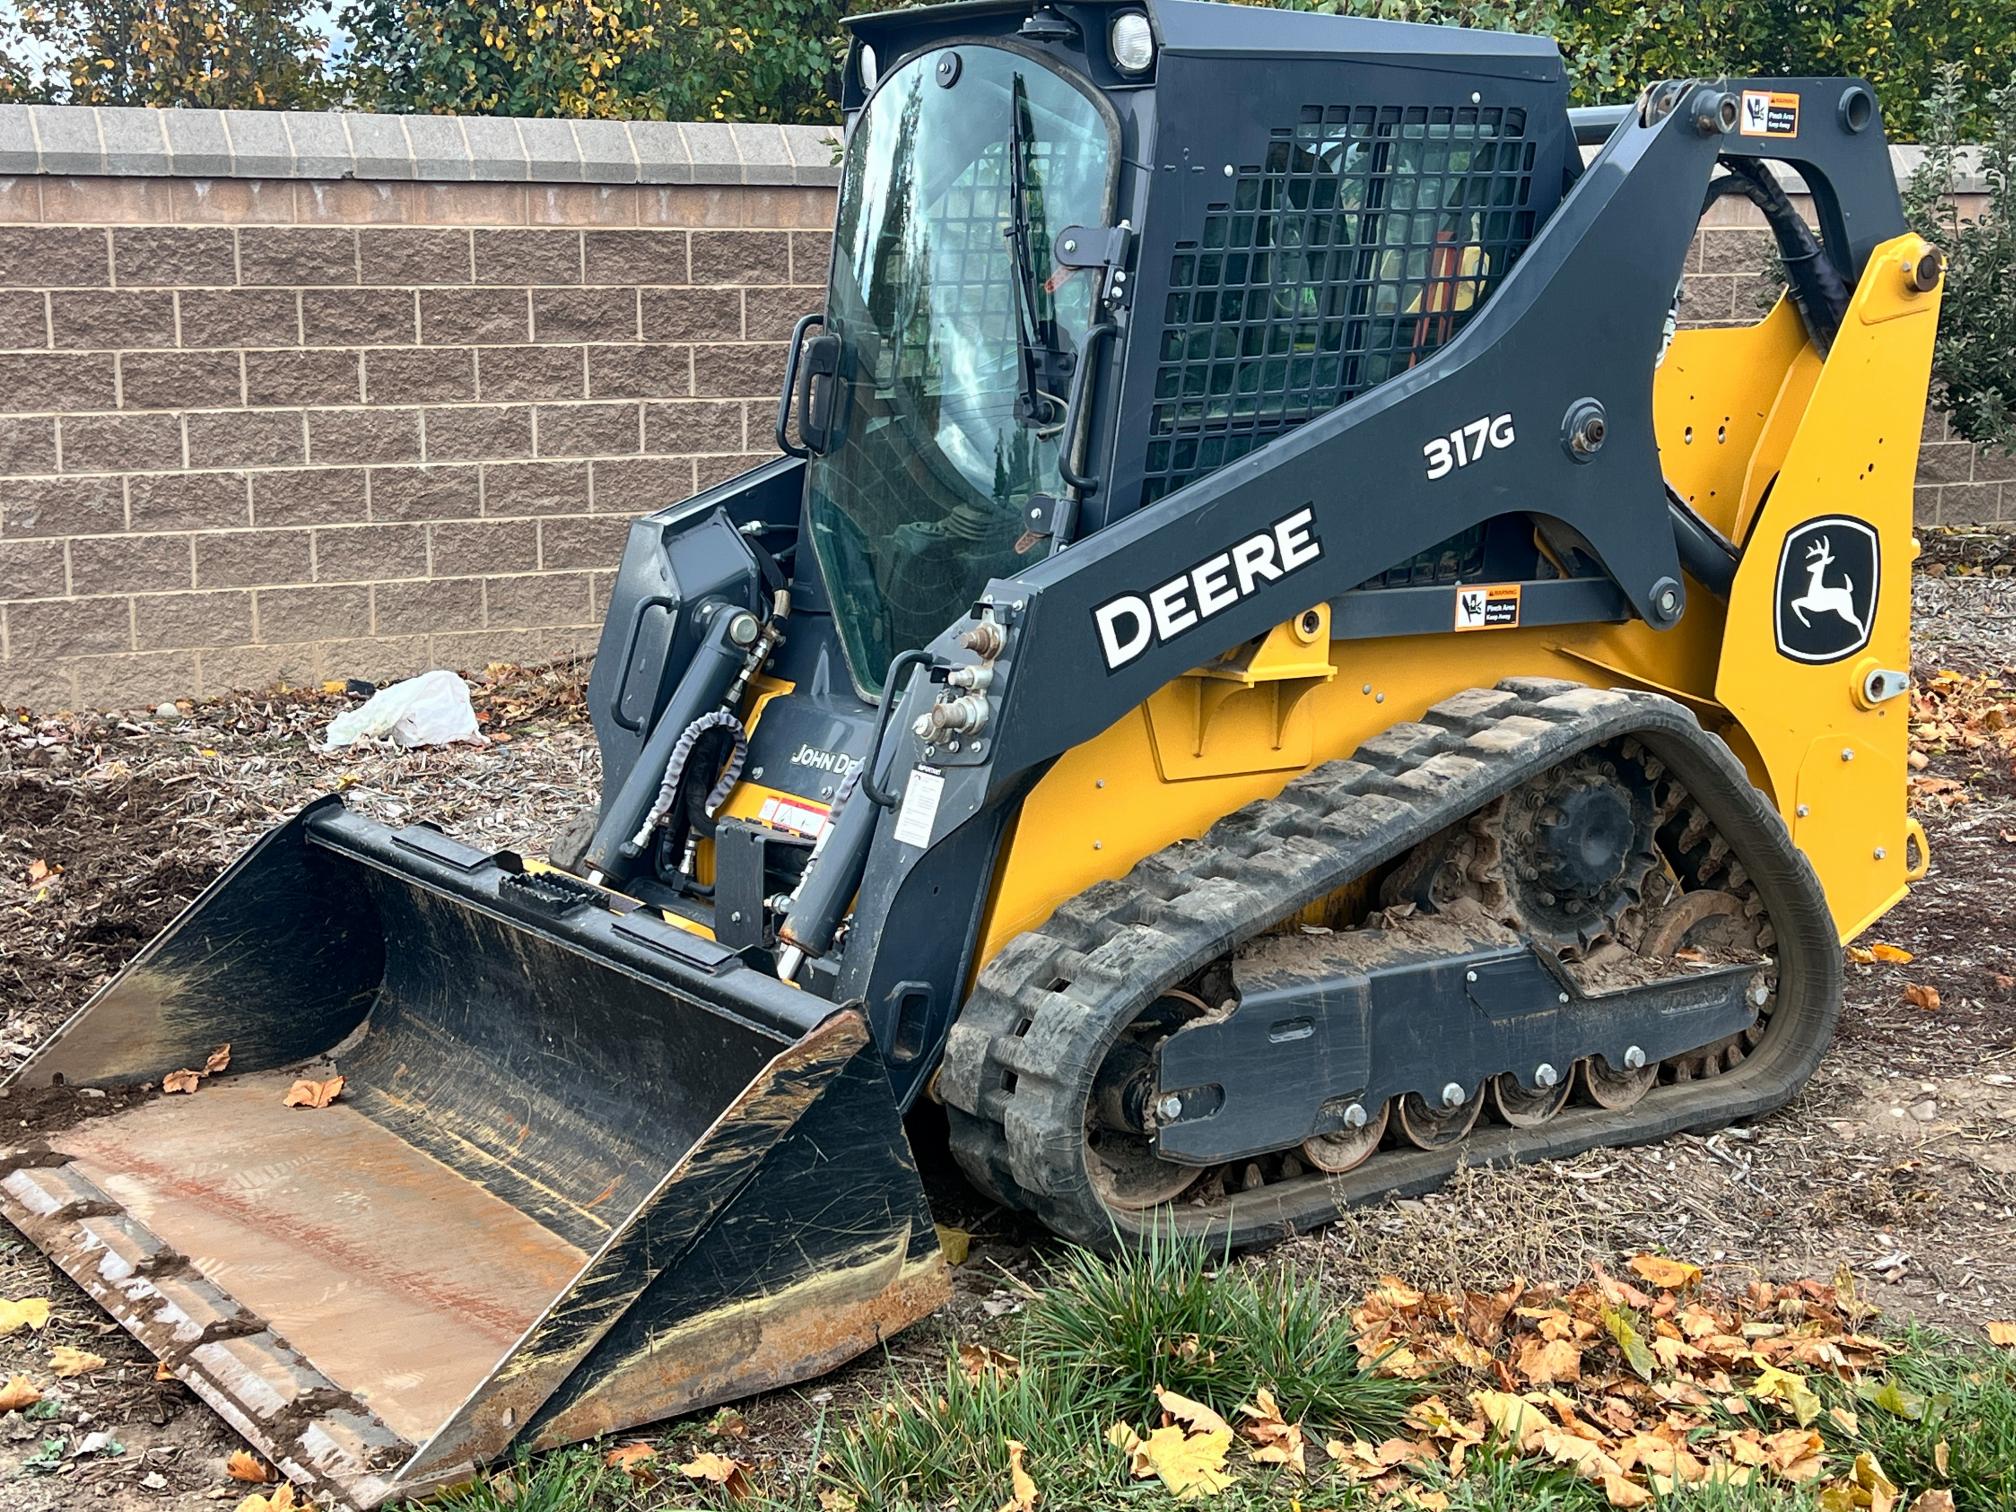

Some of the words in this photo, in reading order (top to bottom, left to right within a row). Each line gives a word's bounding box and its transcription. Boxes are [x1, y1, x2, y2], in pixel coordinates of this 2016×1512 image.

[1782, 112, 1795, 120] Area
[1423, 413, 1515, 480] 317G
[1095, 507, 1321, 669] DEERE
[1486, 604, 1502, 613] Pinch
[1502, 603, 1516, 611] Area
[1498, 613, 1511, 621] Away
[791, 743, 836, 771] JOHN
